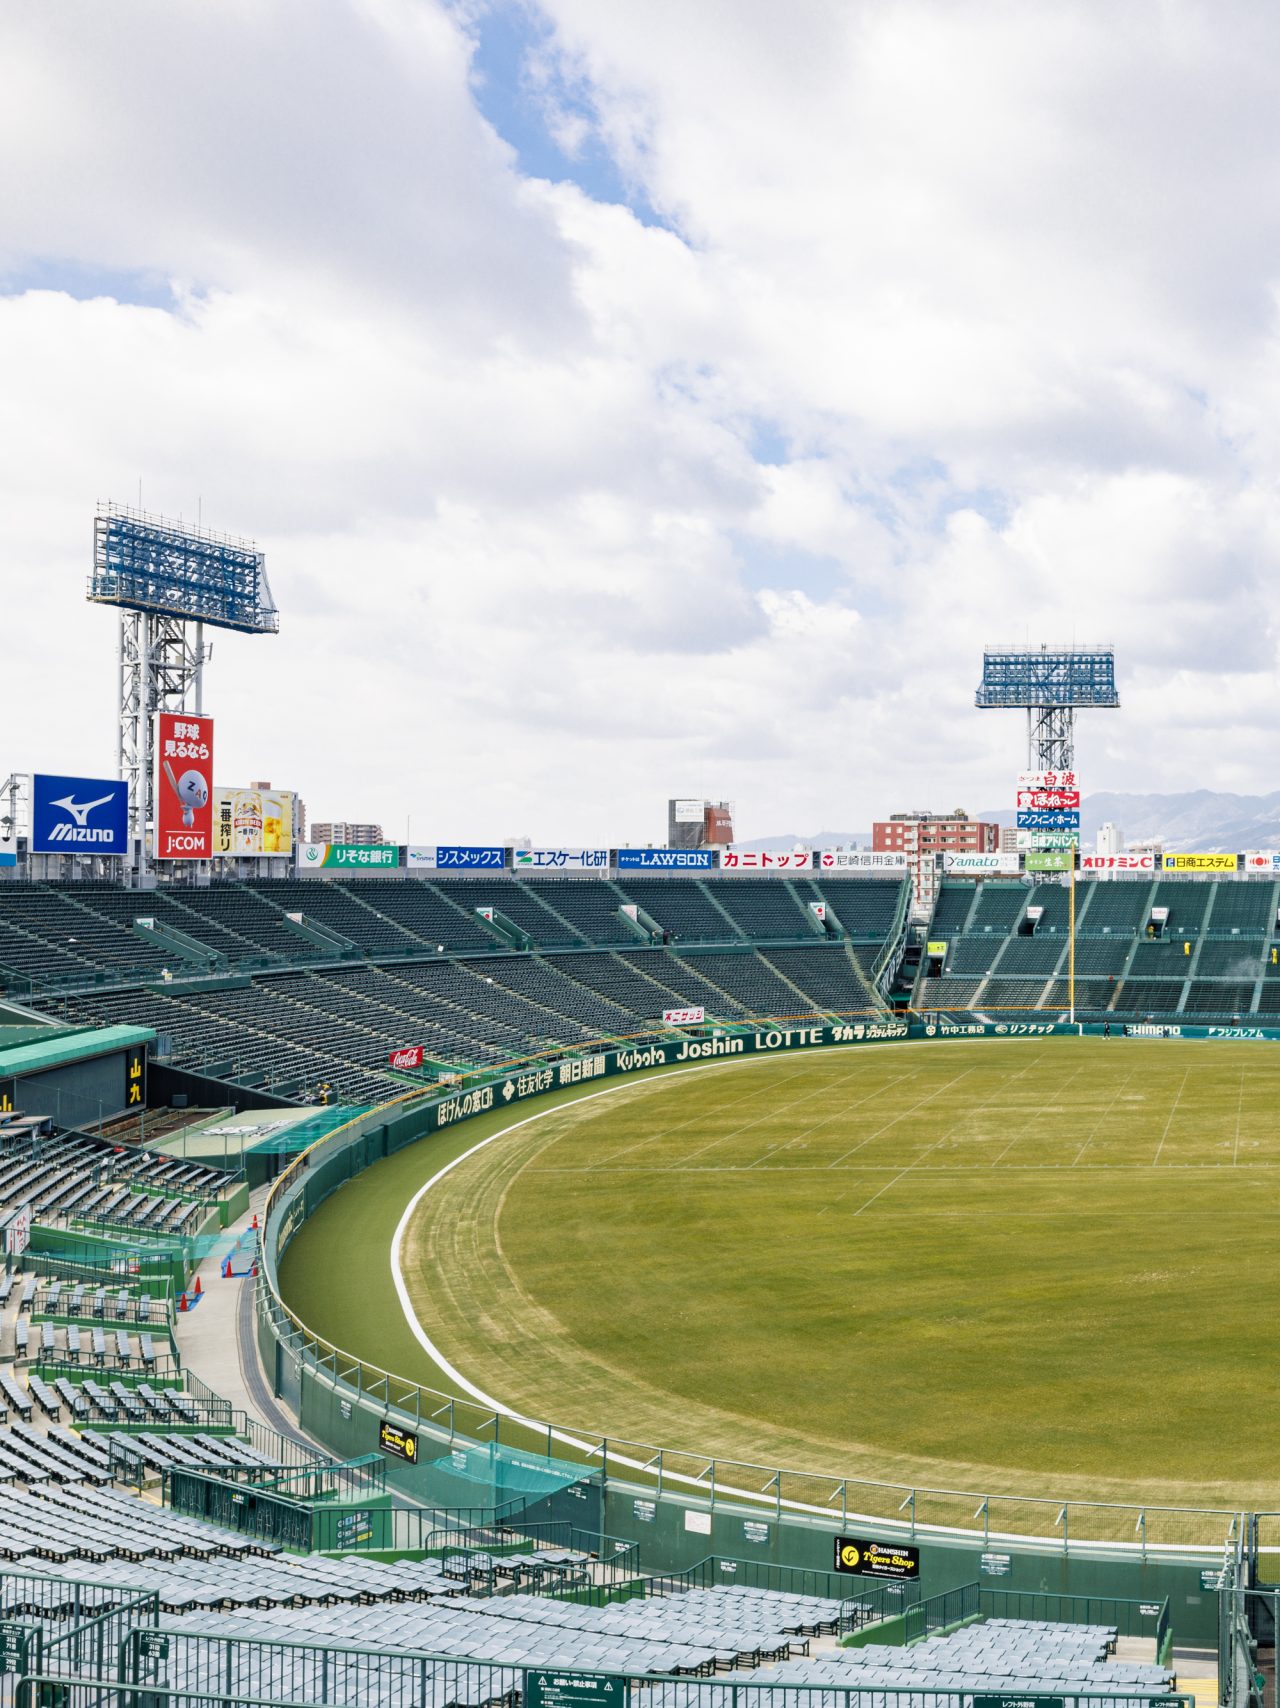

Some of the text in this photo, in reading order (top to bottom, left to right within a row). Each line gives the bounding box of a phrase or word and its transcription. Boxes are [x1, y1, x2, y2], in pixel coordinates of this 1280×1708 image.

[174, 721, 200, 740] 野球
[164, 740, 209, 759] 見るなら
[1043, 771, 1076, 786] 白波
[1034, 793, 1078, 806] ほねっこ
[220, 801, 232, 851] 一番搾り
[166, 836, 206, 853] J:COM
[336, 849, 393, 864] りそな銀行
[438, 850, 502, 865] シスメックス
[533, 850, 607, 867] エスケー化研
[640, 853, 709, 866] LAWSON
[723, 852, 809, 868] カニトップ
[837, 854, 905, 866] 尼崎信用金庫
[1083, 857, 1153, 868] オロナミンC
[1176, 857, 1234, 868] 日商エステム
[755, 1028, 823, 1049] LOTTE
[831, 1025, 865, 1041] タカラ
[941, 1025, 985, 1035] 竹中工務店
[677, 1036, 744, 1060] Joshin
[617, 1047, 666, 1071] Kubota
[559, 1055, 606, 1085] 朝日新聞
[130, 1058, 142, 1104] 山九
[517, 1069, 554, 1097] 住友化学
[438, 1087, 490, 1125] ほけんの窓口
[863, 1551, 915, 1568] Tigers Shop
[878, 1547, 909, 1557] HANSHIN
